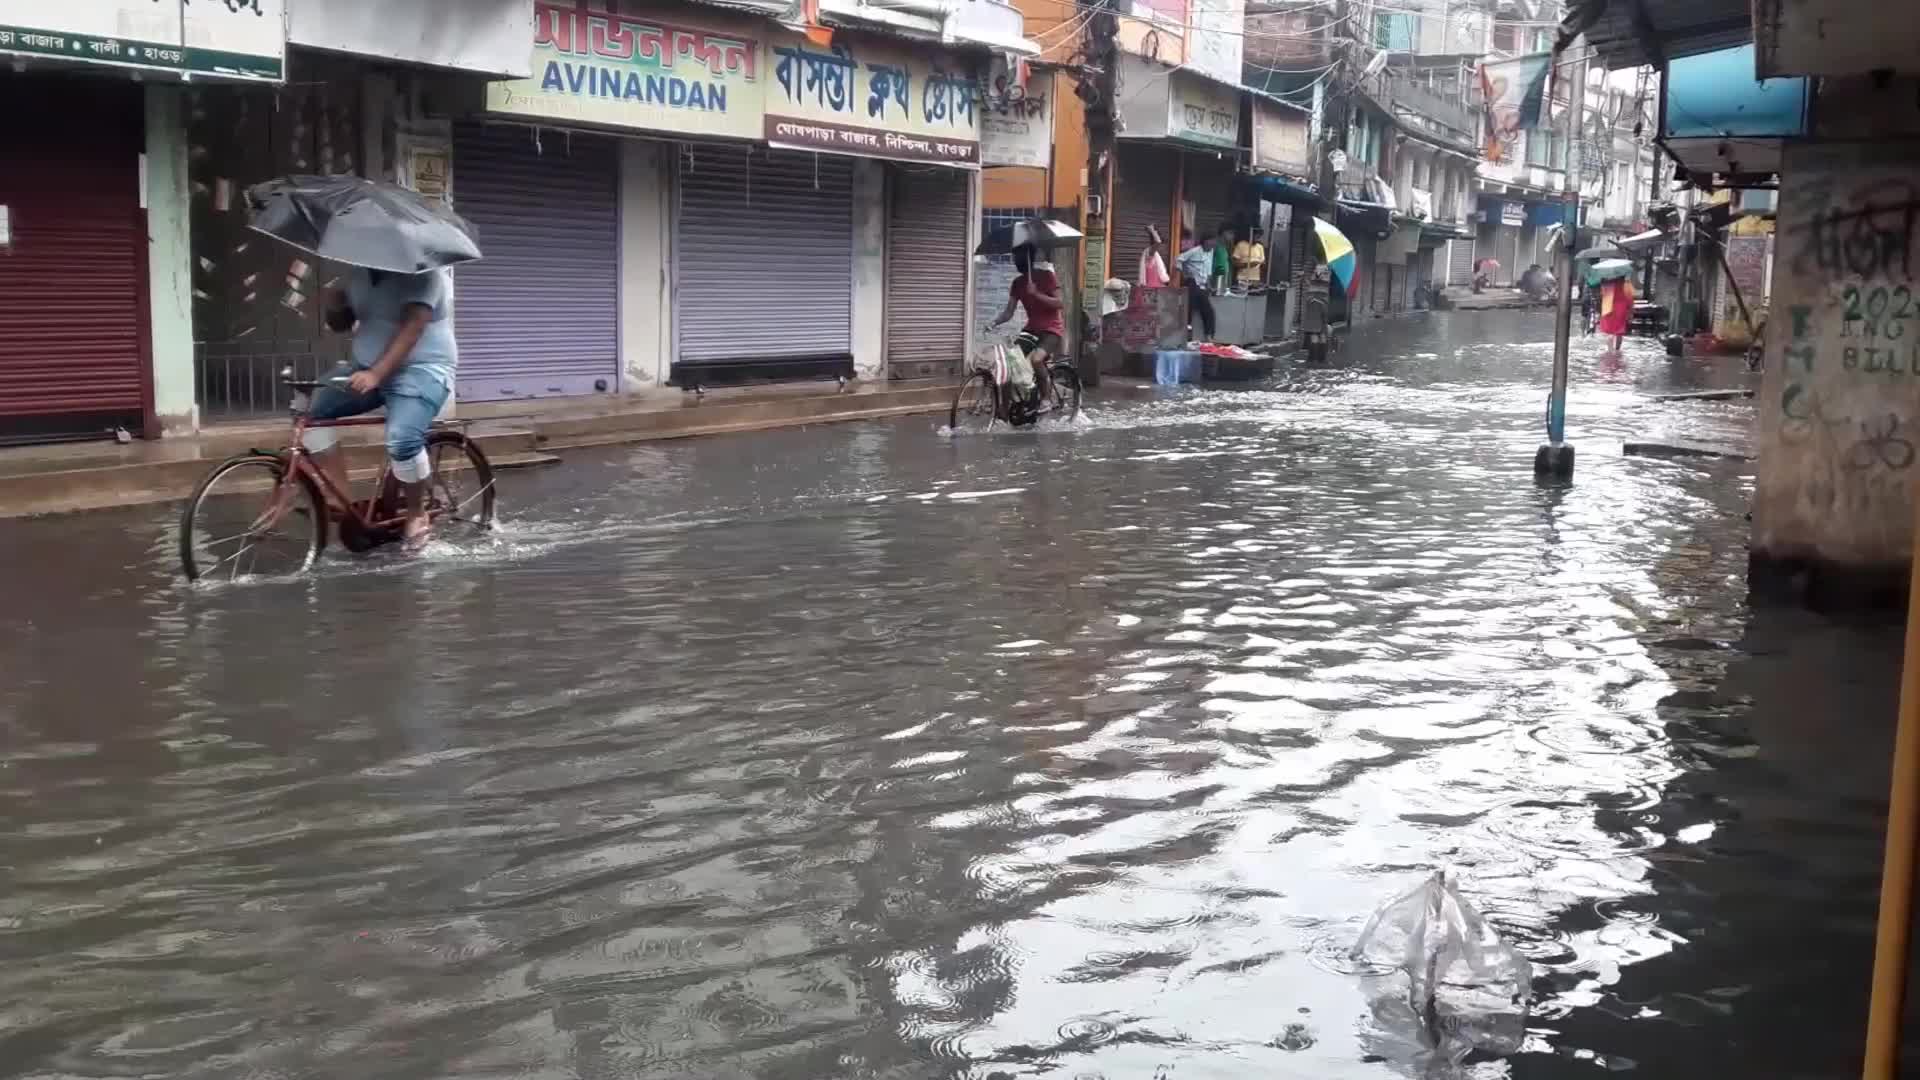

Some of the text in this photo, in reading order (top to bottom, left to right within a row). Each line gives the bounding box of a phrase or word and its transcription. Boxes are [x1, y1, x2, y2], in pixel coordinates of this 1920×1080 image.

[20, 33, 64, 49] বাজার
[88, 40, 120, 55] বালী
[144, 47, 185, 63] হাওড়
[541, 60, 727, 112] AVINANDAN
[772, 45, 858, 112] বাসন্তী
[776, 122, 835, 140] ঘোষপাড়া
[840, 130, 880, 148] বাজার,
[936, 142, 972, 157] হাওড়া
